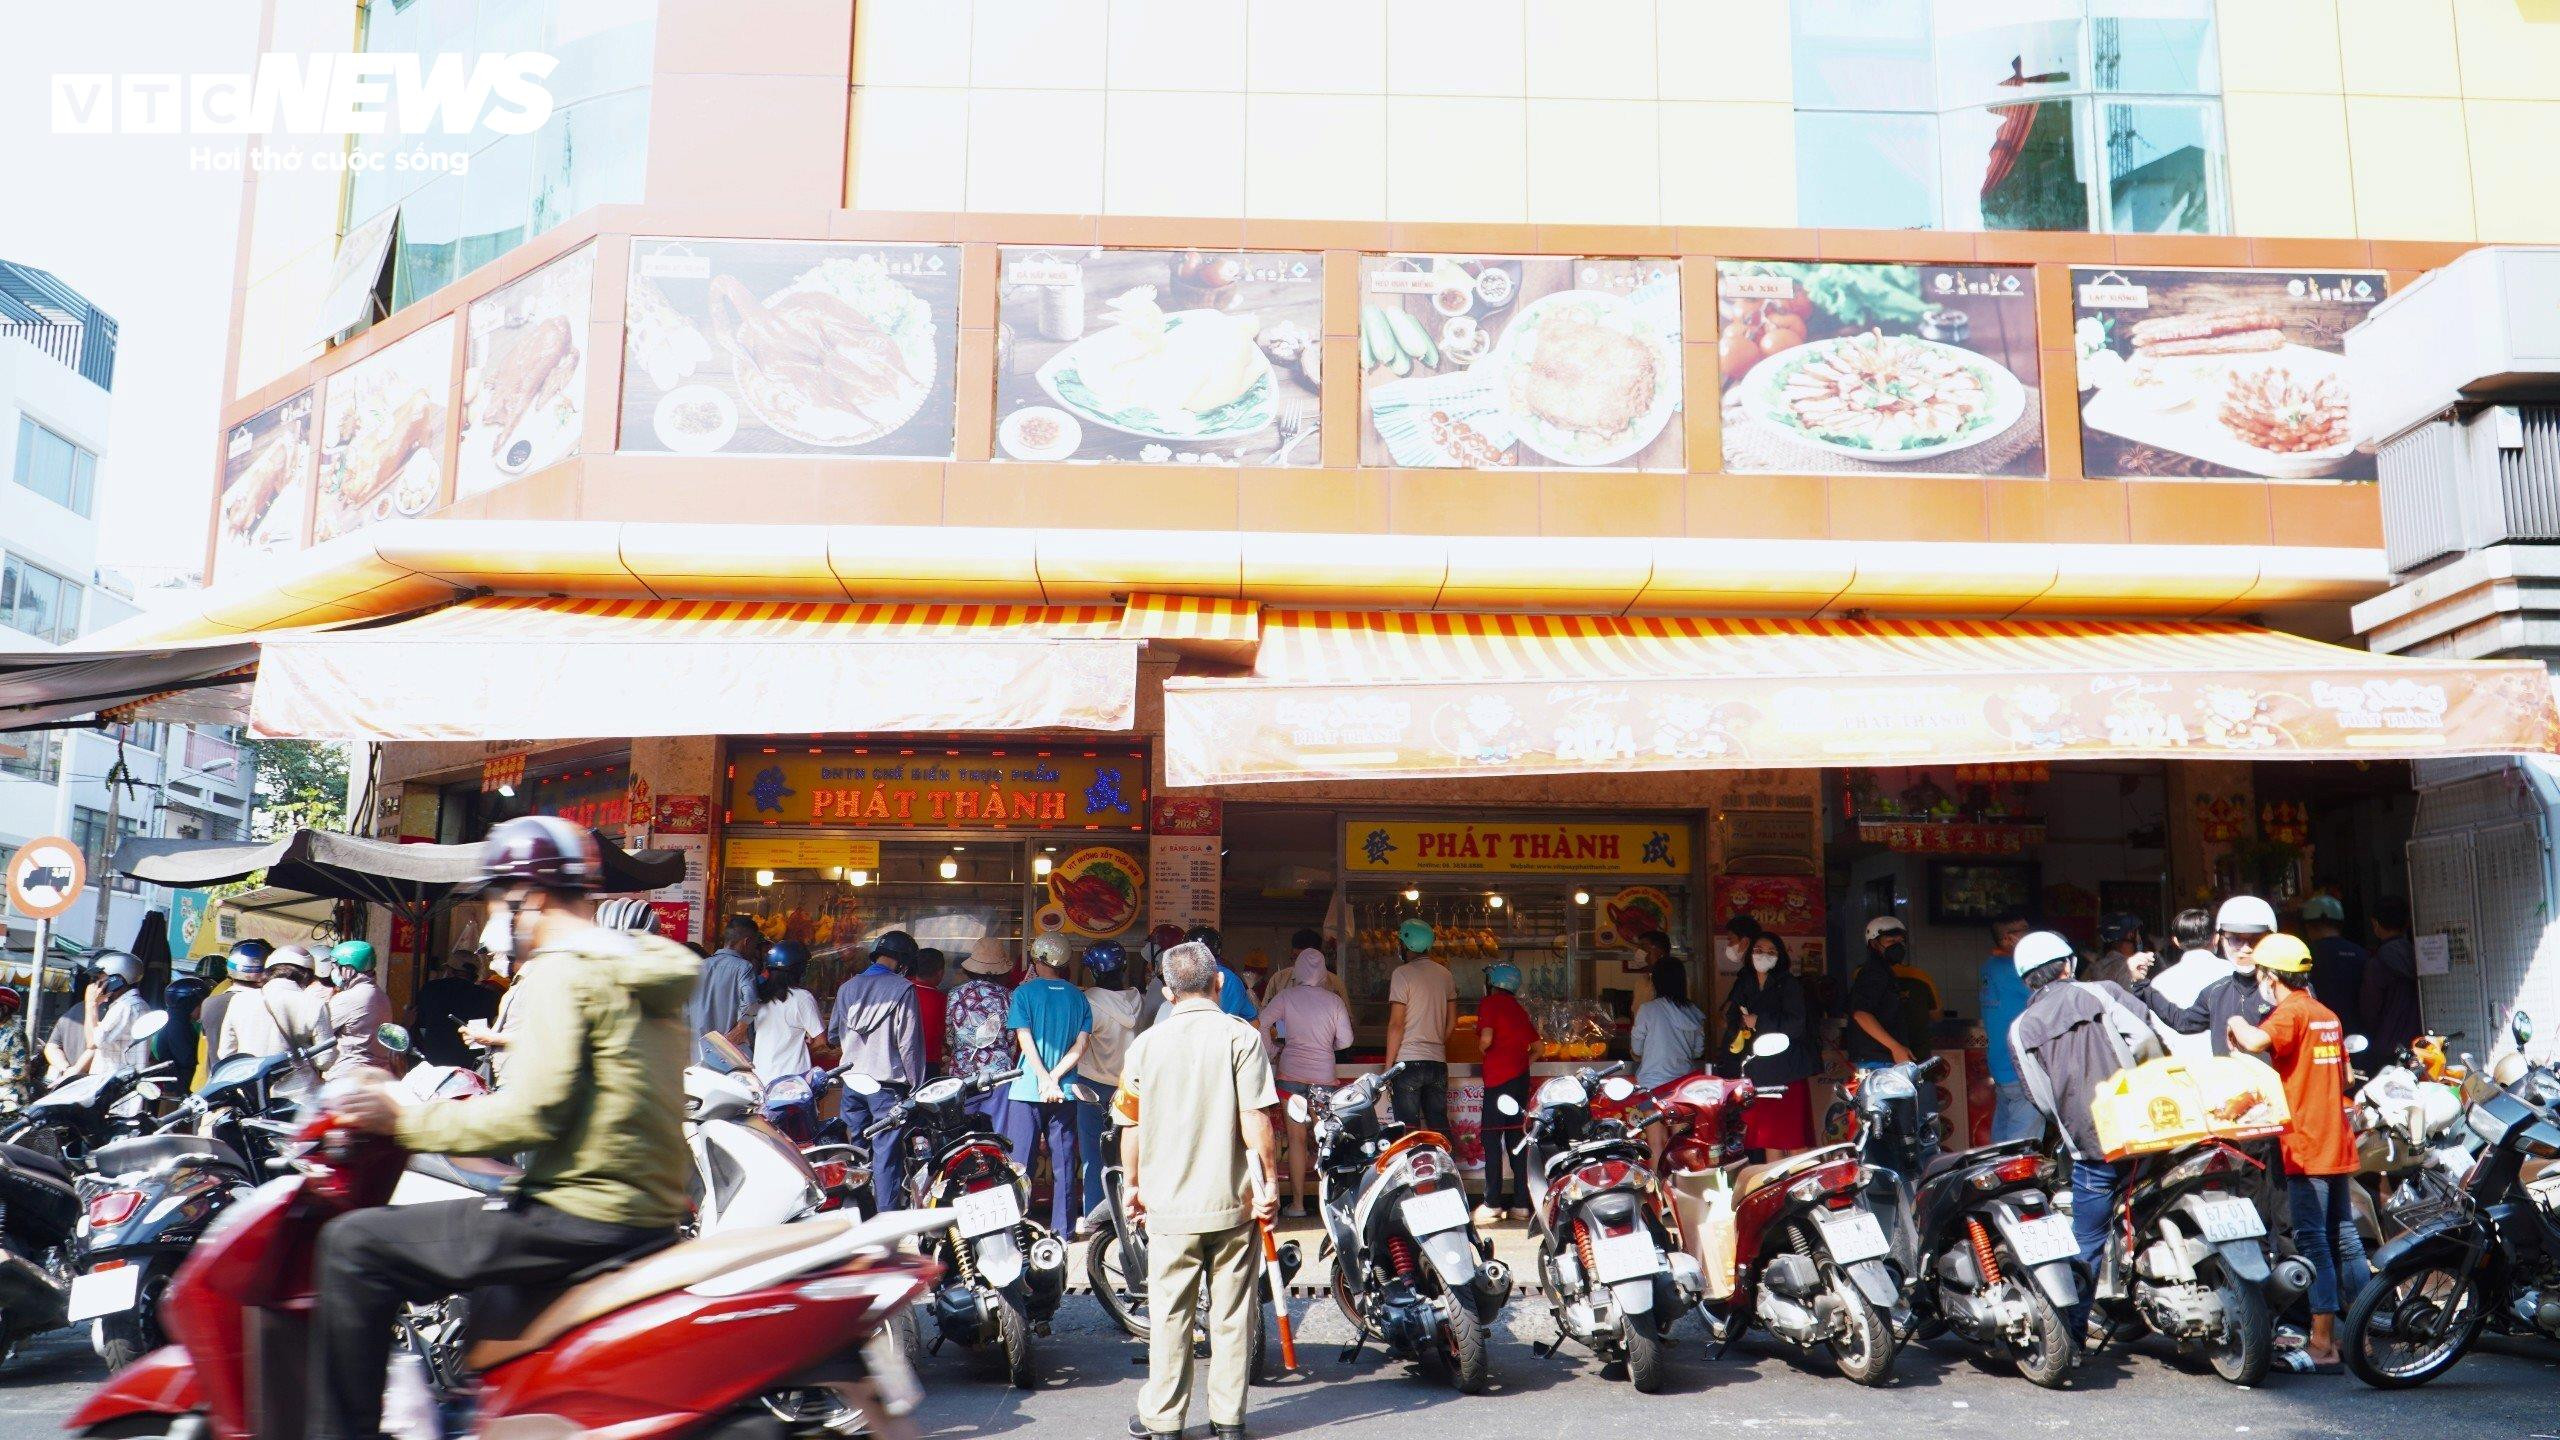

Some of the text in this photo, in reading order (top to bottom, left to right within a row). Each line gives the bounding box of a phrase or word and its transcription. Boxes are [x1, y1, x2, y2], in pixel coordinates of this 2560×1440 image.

[811, 781, 1068, 820] PHÁT THÀNH
[1174, 818, 1198, 829] 2024
[1417, 825, 1620, 861] PHÁT THÀNH
[1751, 908, 1787, 924] 2024
